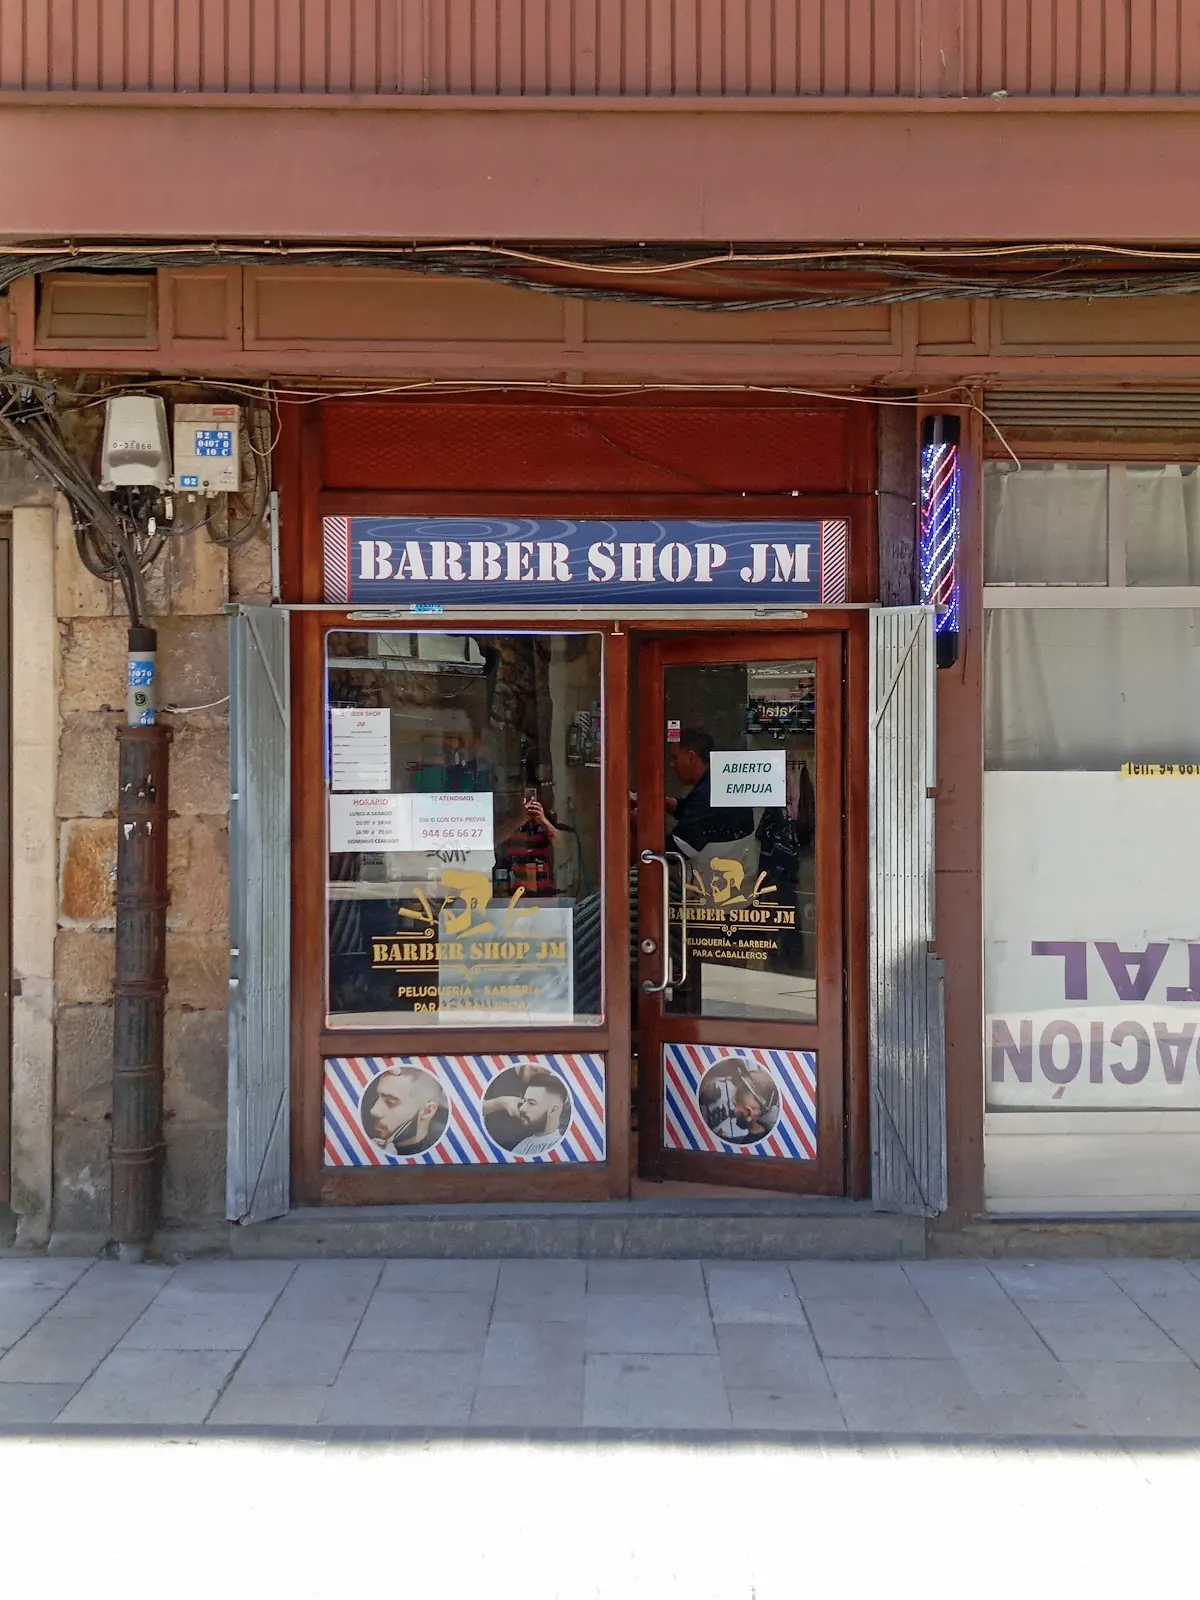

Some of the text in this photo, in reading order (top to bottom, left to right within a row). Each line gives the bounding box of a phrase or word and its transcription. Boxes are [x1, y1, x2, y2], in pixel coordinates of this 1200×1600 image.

[183, 477, 197, 485] 02
[358, 540, 811, 583] BARBER SHOP JM
[722, 763, 772, 773] ABIERTO
[726, 783, 773, 794] EMPUJA
[353, 798, 389, 806] HORARIO
[422, 829, 483, 838] 944 66 66 27
[668, 907, 796, 924] BARBER SHOP JM
[738, 937, 778, 949] BARBERÍA
[372, 941, 567, 962] BARBER SHOP JM
[692, 949, 768, 960] PARA CABALLEROS
[398, 983, 473, 998] PELUQUERÍA
[991, 1019, 1200, 1100] ACIÓN
